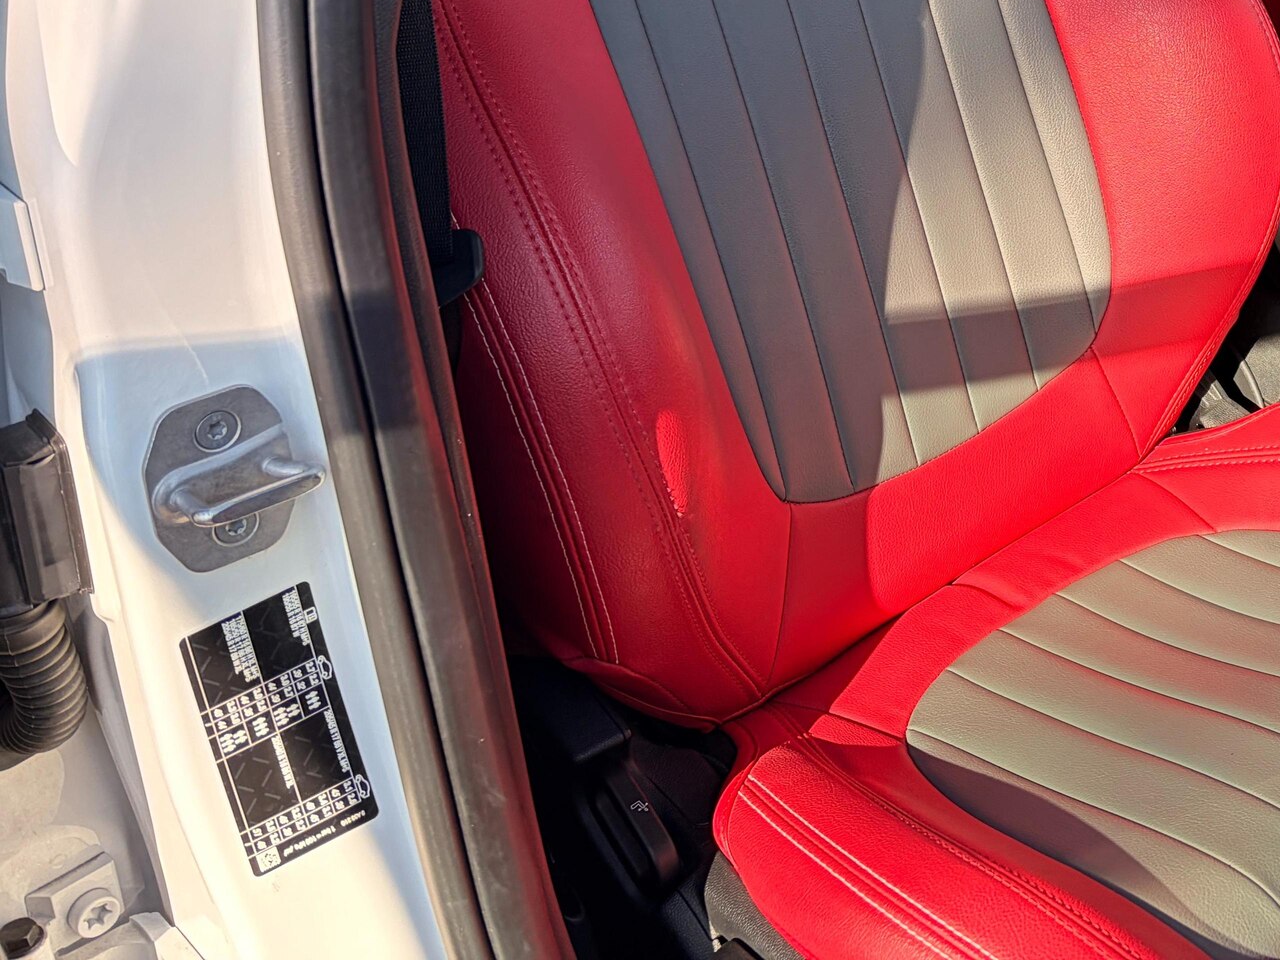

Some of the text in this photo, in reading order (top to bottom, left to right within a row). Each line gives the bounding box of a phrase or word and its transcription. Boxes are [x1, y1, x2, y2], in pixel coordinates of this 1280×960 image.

[304, 660, 319, 686] 2.7 2.2
[266, 680, 277, 692] 44
[295, 679, 306, 691] 32
[283, 685, 294, 698] 2.7
